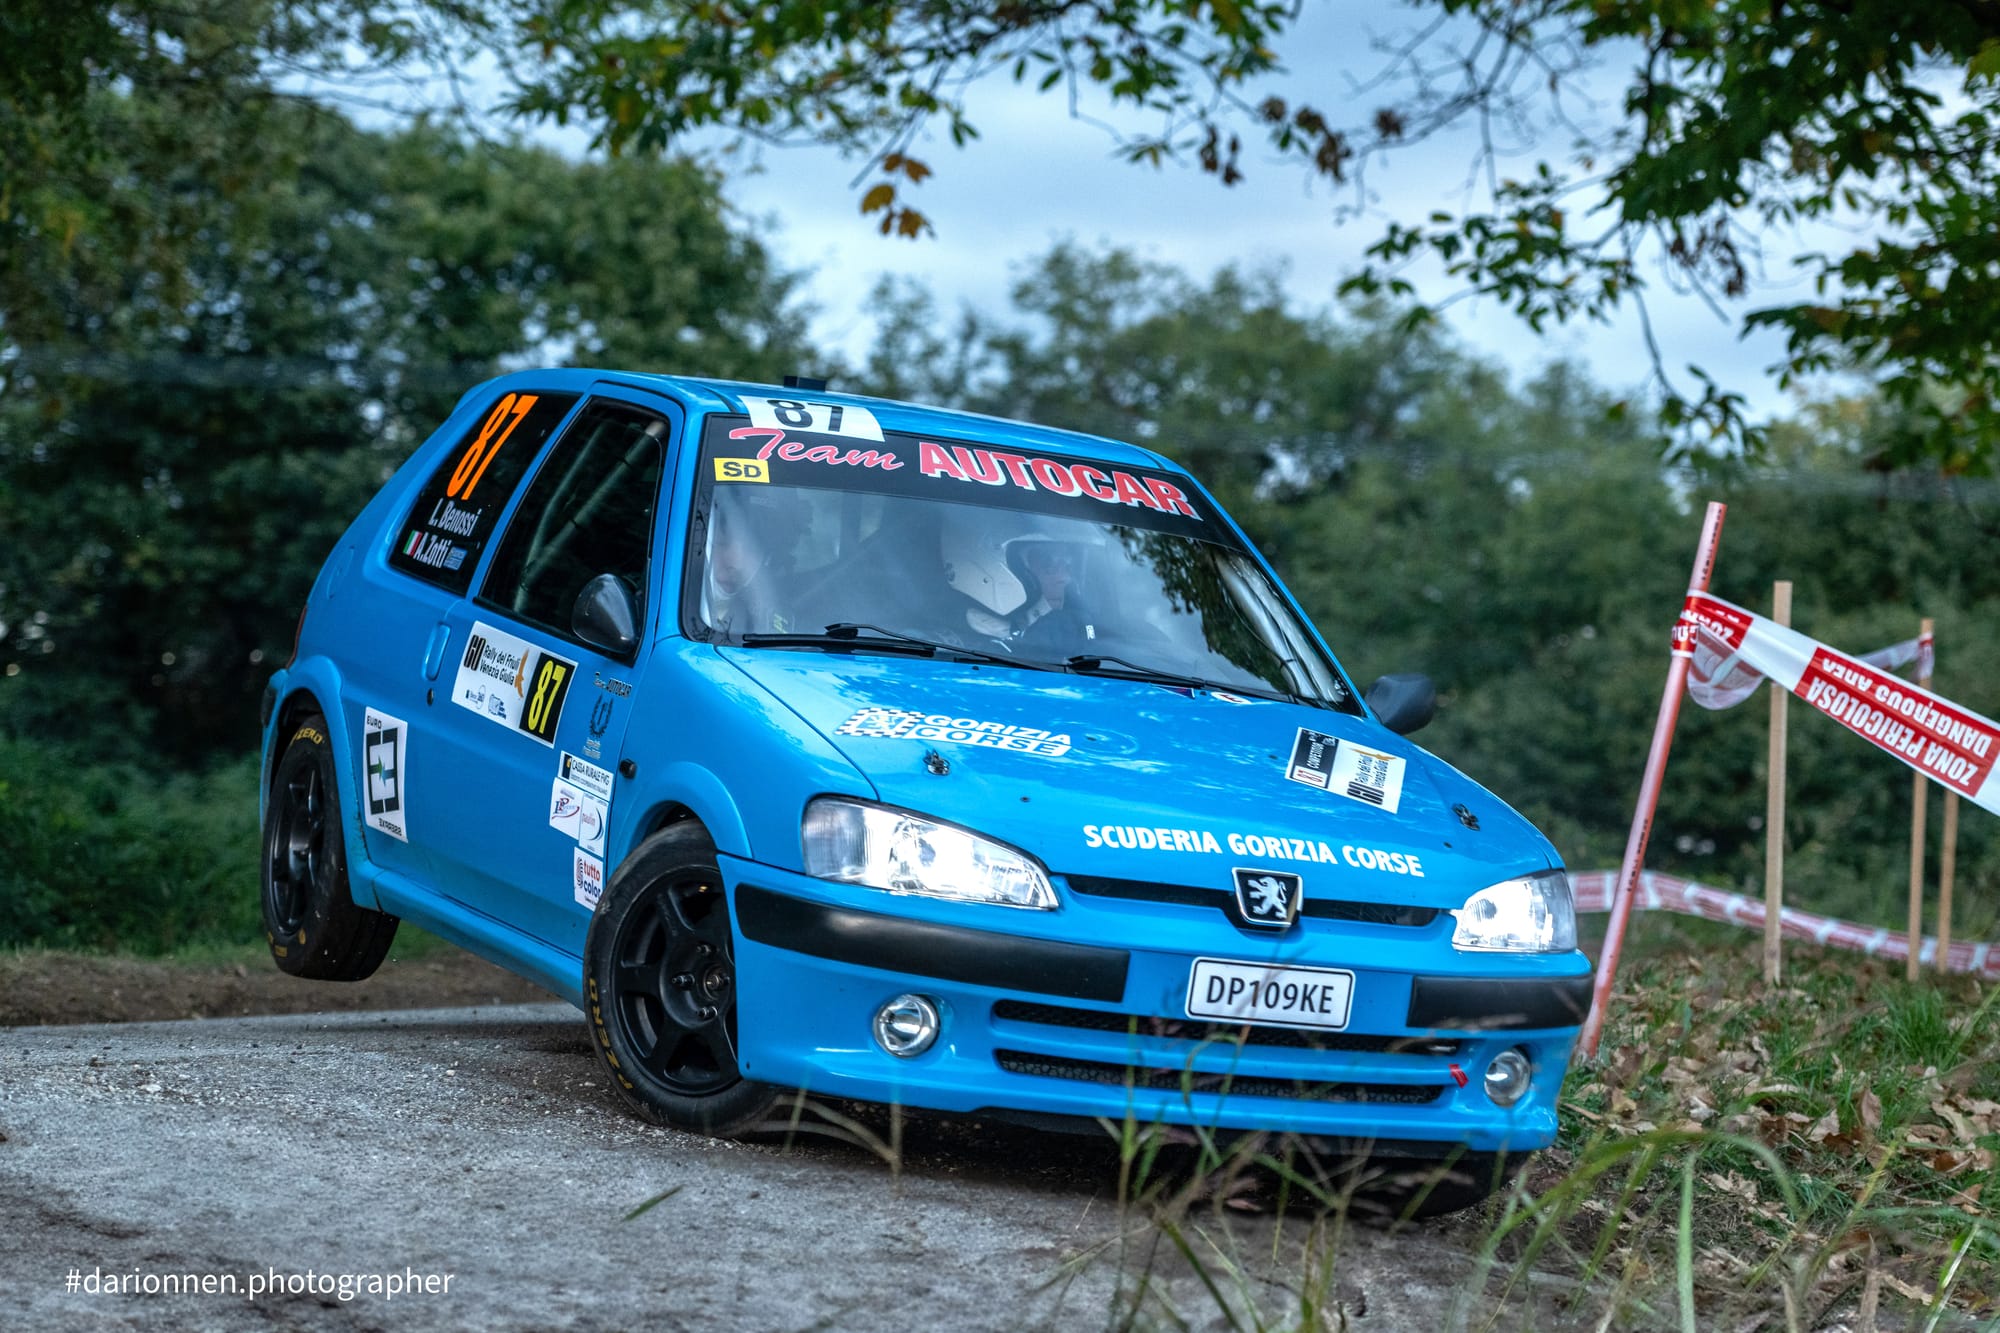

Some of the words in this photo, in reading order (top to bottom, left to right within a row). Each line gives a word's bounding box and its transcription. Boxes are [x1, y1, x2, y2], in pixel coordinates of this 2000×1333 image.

[767, 399, 844, 433] 87
[447, 393, 539, 501] 87
[722, 461, 762, 479] SD
[729, 427, 904, 471] Team
[919, 441, 1204, 521] AUTOCAR
[438, 499, 482, 537] Benossi
[464, 635, 487, 672] 60
[483, 644, 499, 667] Rally
[496, 650, 507, 665] del
[528, 660, 567, 735] 87
[924, 714, 1072, 746] GORIZIA
[1805, 676, 1928, 759] PERICOLOSA
[915, 726, 1059, 755] CORSE
[1923, 745, 1979, 787] ZONA
[1083, 825, 1223, 854] SCUDERIA
[1227, 833, 1339, 864] GORIZIA
[1341, 845, 1425, 877] CORSE
[583, 859, 601, 882] tutto
[1206, 975, 1335, 1014] DP109KE
